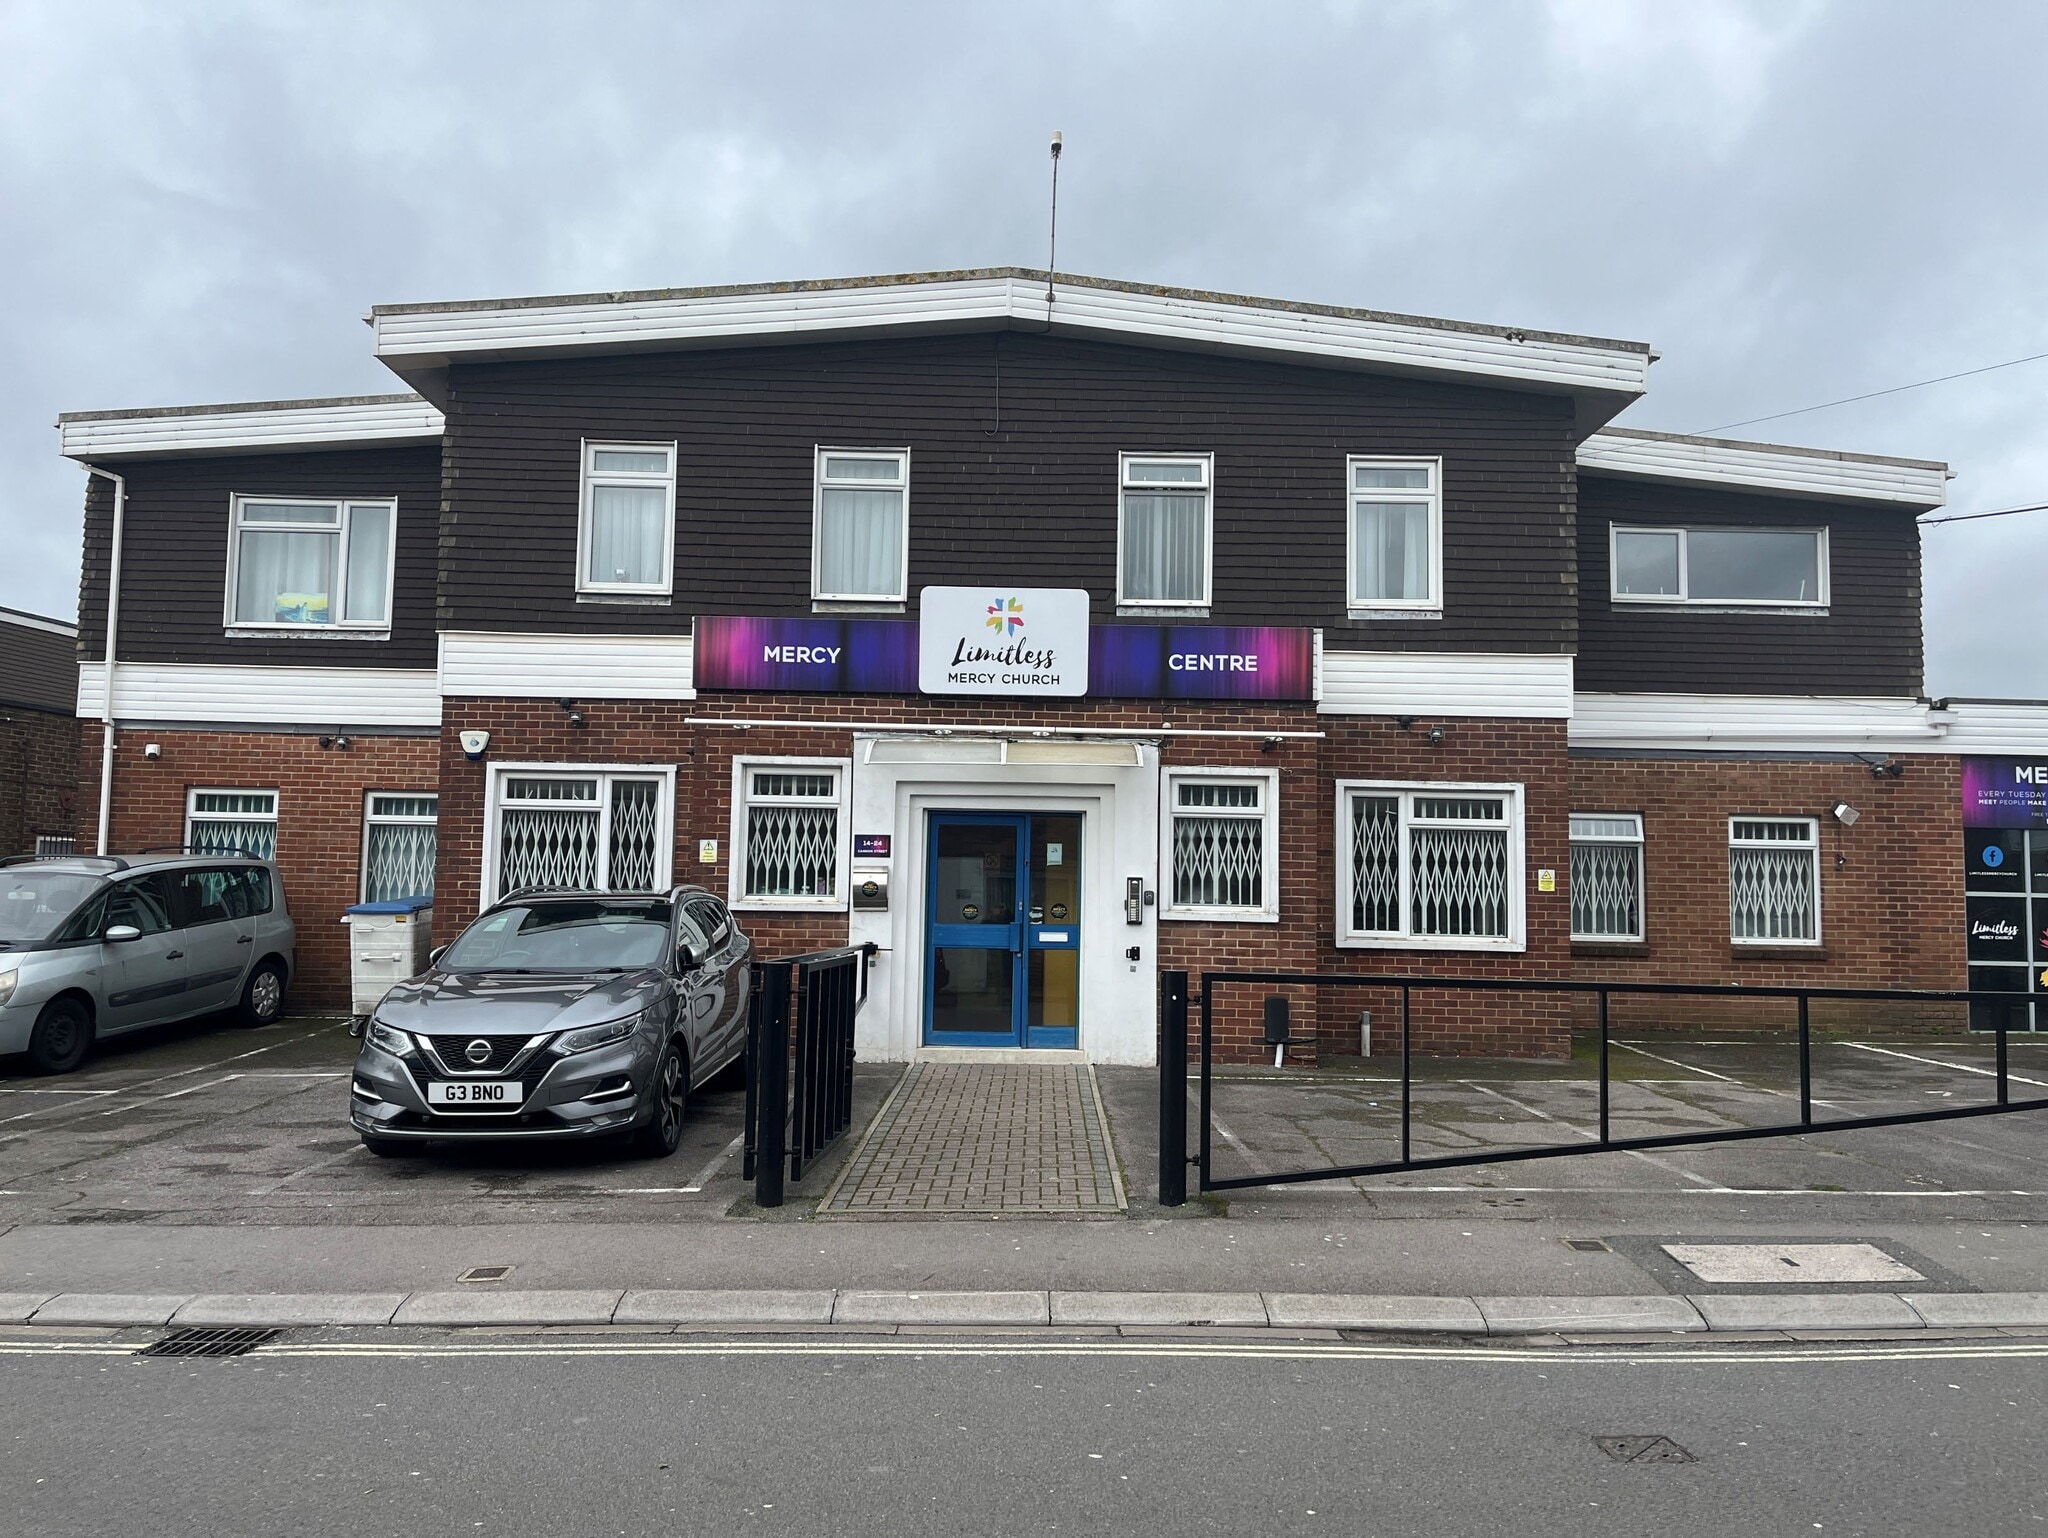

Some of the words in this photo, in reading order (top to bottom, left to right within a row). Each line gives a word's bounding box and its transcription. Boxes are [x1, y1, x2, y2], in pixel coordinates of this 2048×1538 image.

[764, 646, 841, 664] MERCY
[951, 636, 1057, 669] Limitless
[1168, 654, 1258, 671] CENTRE
[948, 673, 995, 683] MERCY
[1001, 674, 1060, 685] CHURCH
[1972, 920, 2019, 935] Limitless
[446, 1085, 467, 1100] G3
[472, 1085, 504, 1100] BNO
